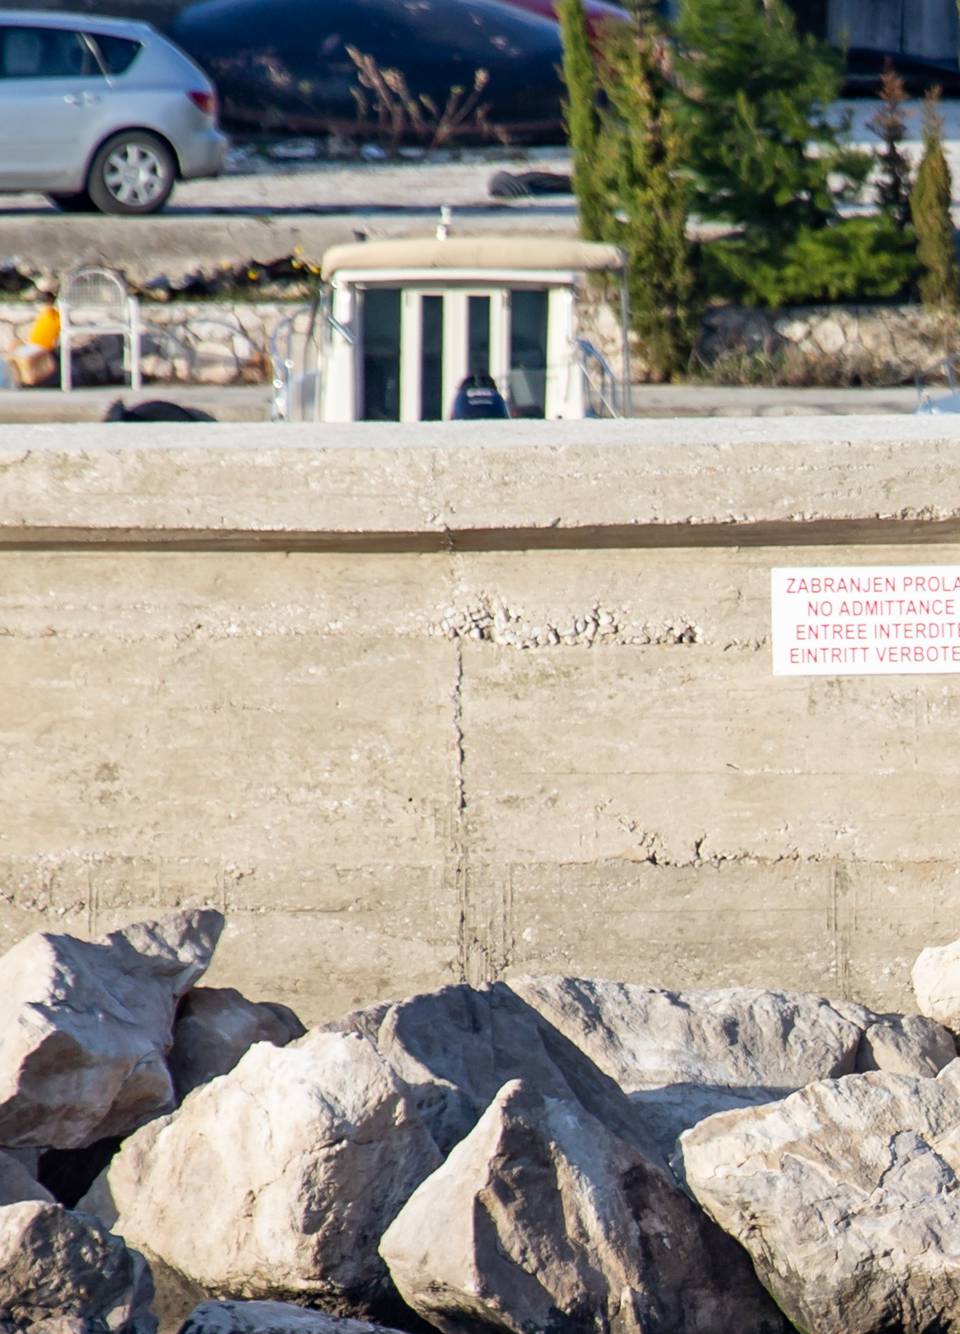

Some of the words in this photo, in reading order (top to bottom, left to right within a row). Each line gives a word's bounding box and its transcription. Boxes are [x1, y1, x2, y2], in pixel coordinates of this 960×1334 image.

[786, 577, 896, 594] ZABRANJEN
[807, 601, 833, 617] NO
[839, 599, 956, 616] ADMITTANCE
[796, 624, 867, 640] ENTREE
[790, 648, 869, 663] EINTRITT
